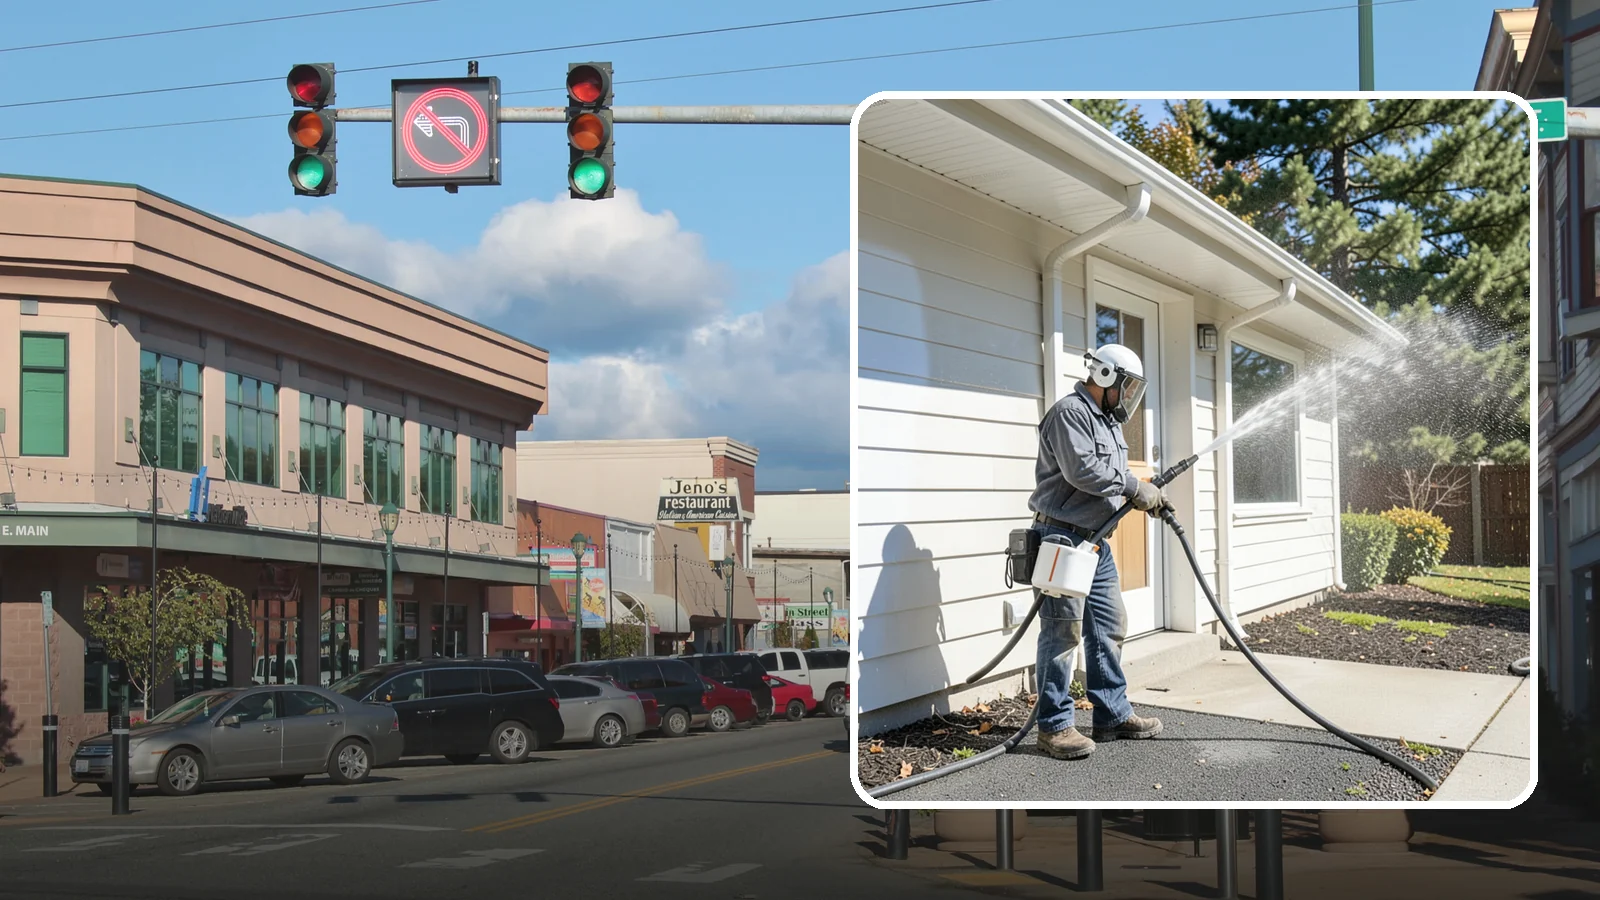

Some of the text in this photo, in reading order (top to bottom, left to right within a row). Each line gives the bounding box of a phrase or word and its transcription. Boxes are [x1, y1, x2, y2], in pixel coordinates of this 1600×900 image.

[670, 480, 728, 494] Jeno's
[665, 496, 730, 508] restaurant
[686, 510, 714, 519] American
[715, 510, 737, 519] Cuisine
[2, 525, 49, 536] E. MAIN
[798, 607, 828, 616] Street
